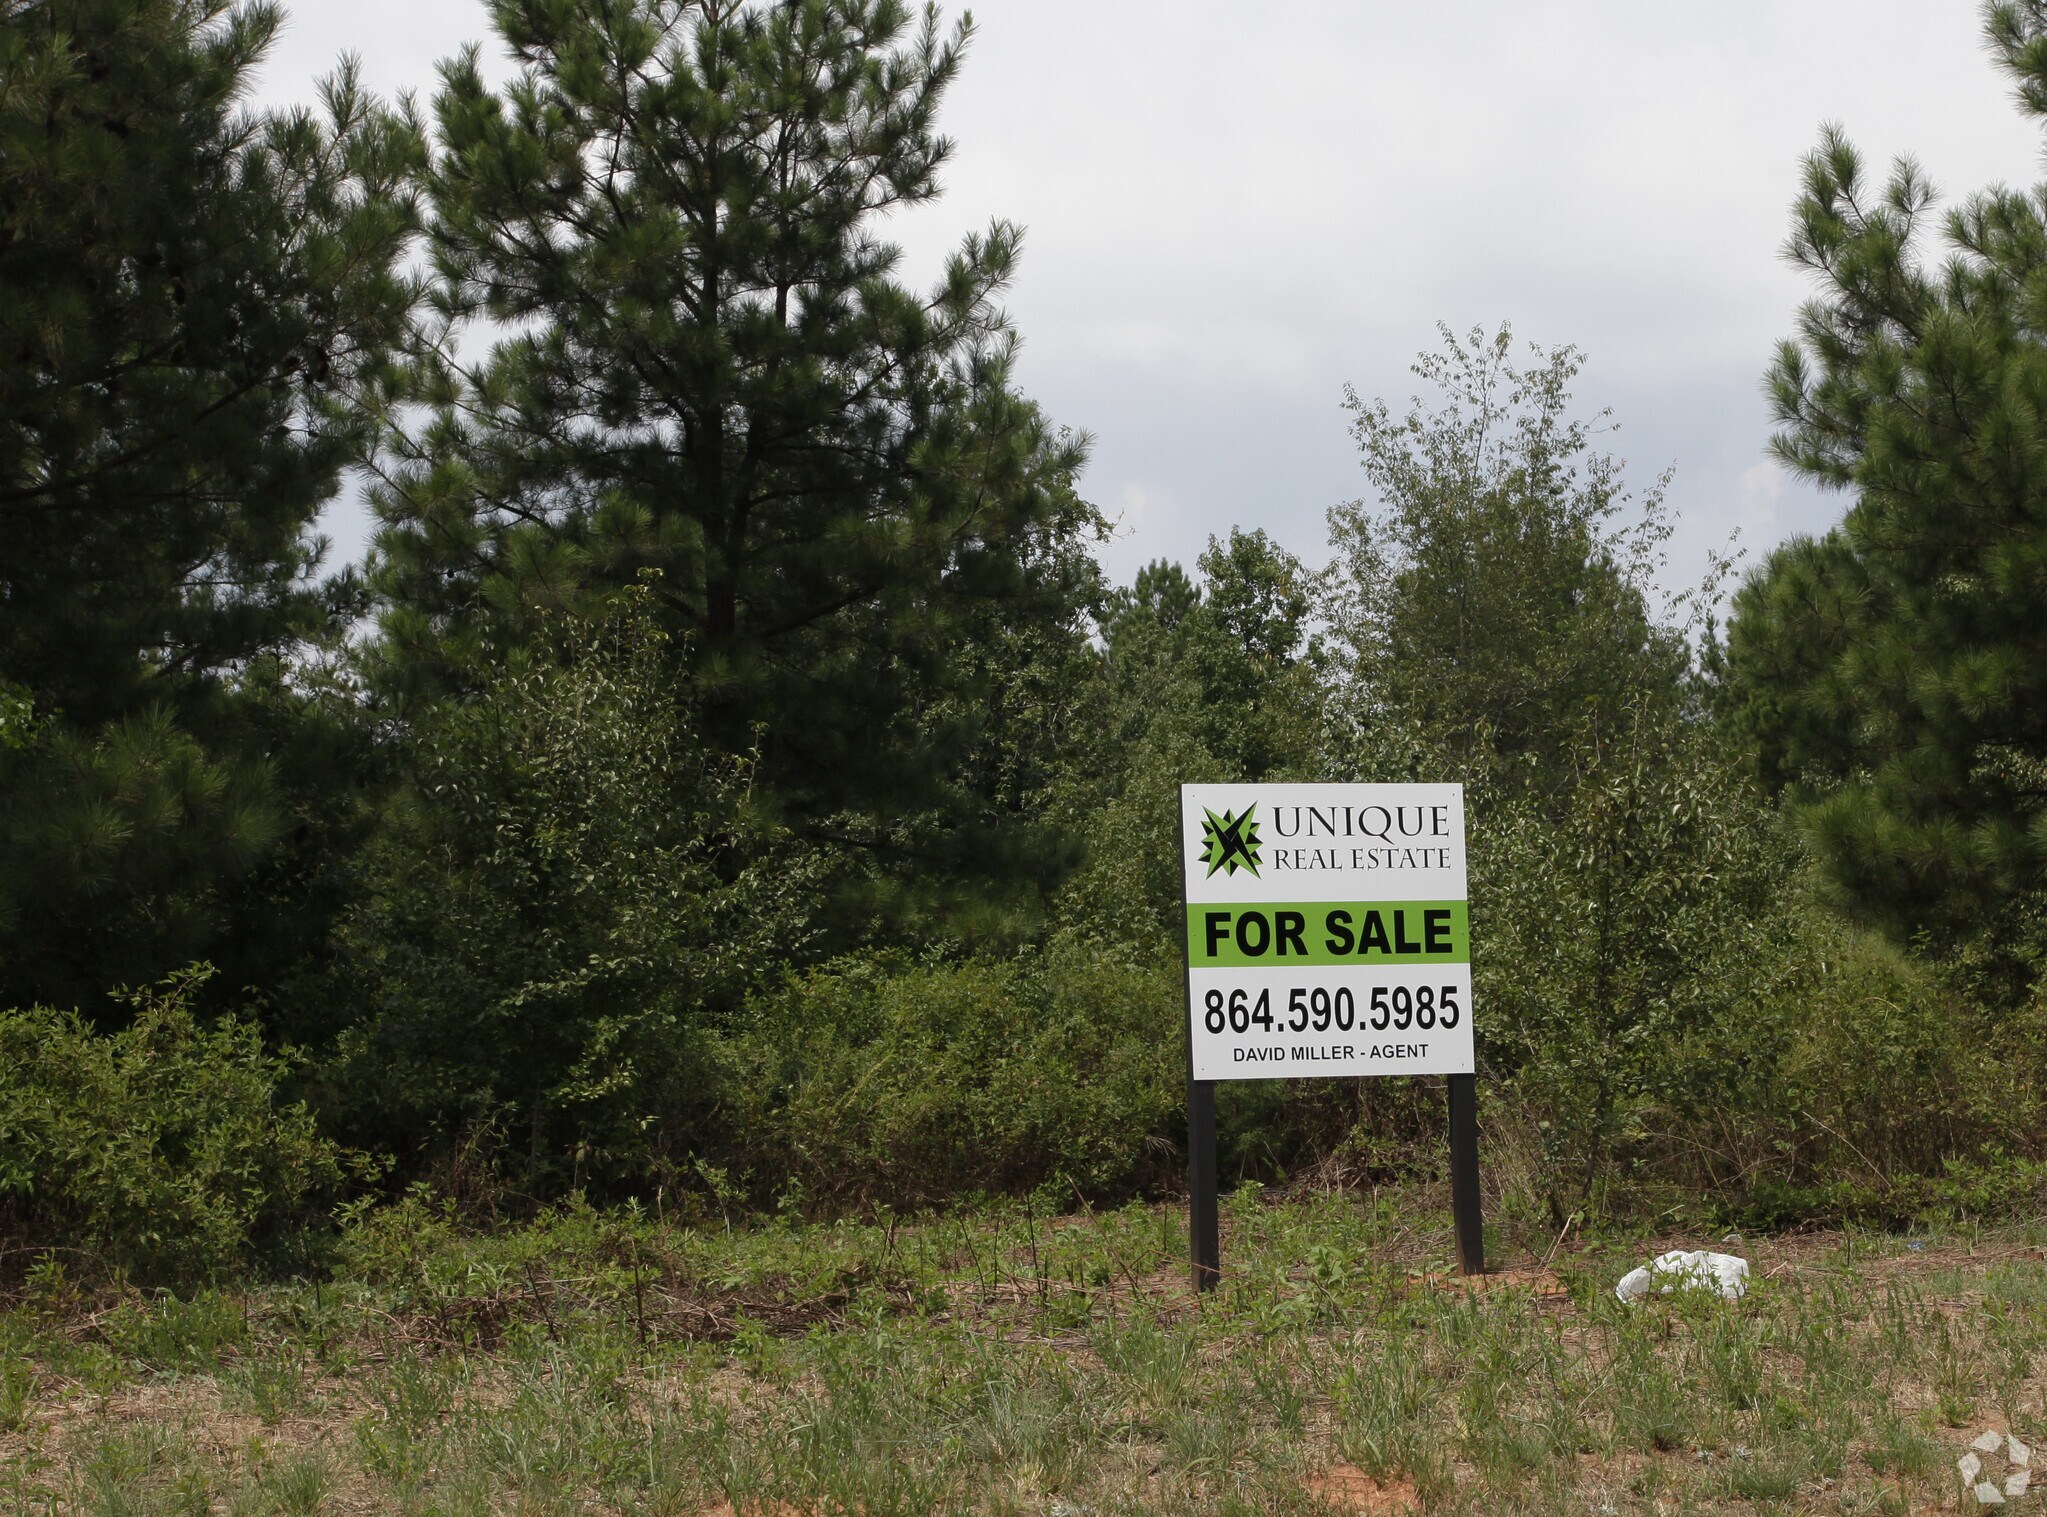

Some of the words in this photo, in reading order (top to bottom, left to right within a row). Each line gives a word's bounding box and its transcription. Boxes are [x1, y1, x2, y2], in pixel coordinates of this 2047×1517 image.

[1273, 805, 1450, 845] UNIQUE
[1273, 848, 1343, 871] REAL
[1351, 847, 1451, 870] ESTATE
[1205, 911, 1308, 957] FOR
[1325, 909, 1453, 956] SALE
[1204, 985, 1460, 1034] 864.590.5985
[1233, 1047, 1285, 1062] DAVID
[1291, 1045, 1354, 1061] MILLER
[1369, 1043, 1429, 1059] AGENT
